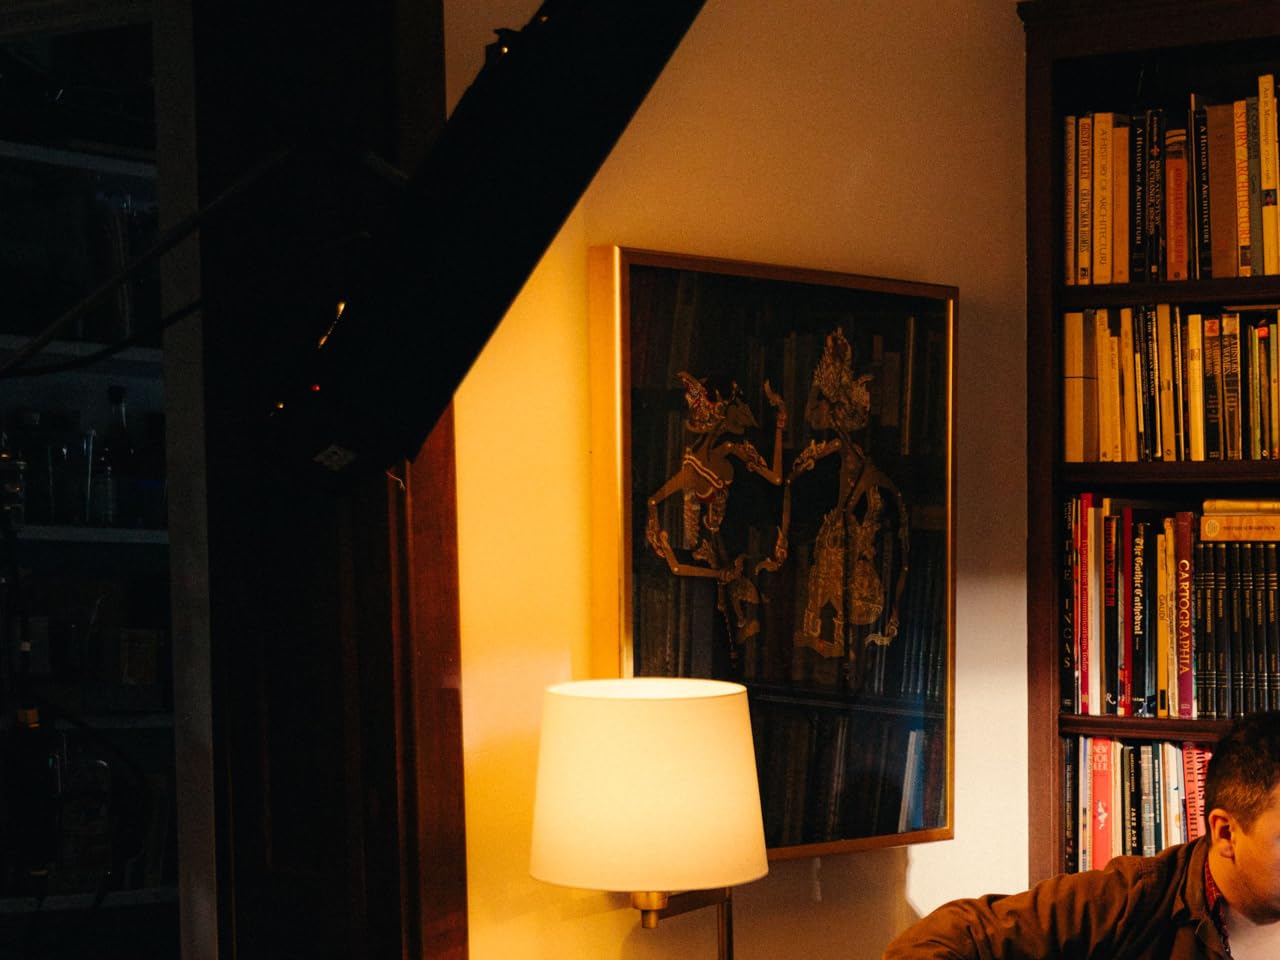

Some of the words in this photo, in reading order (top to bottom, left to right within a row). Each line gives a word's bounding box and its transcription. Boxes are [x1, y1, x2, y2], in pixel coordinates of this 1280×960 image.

[1080, 123, 1089, 146] GUSTAV
[1236, 111, 1246, 148] STORY
[1080, 188, 1090, 228] CRAFTSMAN
[1237, 158, 1250, 243] ARCHITECTURE
[1080, 230, 1090, 253] HOMES
[1099, 197, 1108, 265] ARCHITECTURE
[1223, 346, 1231, 375] WOMEN
[1133, 537, 1144, 556] The
[1132, 556, 1144, 588] Gothic
[1081, 585, 1089, 649] Communications
[1133, 588, 1144, 635] Cathedral
[1178, 559, 1190, 675] CARTOGRAPHIA
[1063, 598, 1073, 669] INCAS
[1081, 650, 1089, 673] Today
[1195, 750, 1206, 800] IONEERS
[1186, 790, 1198, 844] ARCHITE
